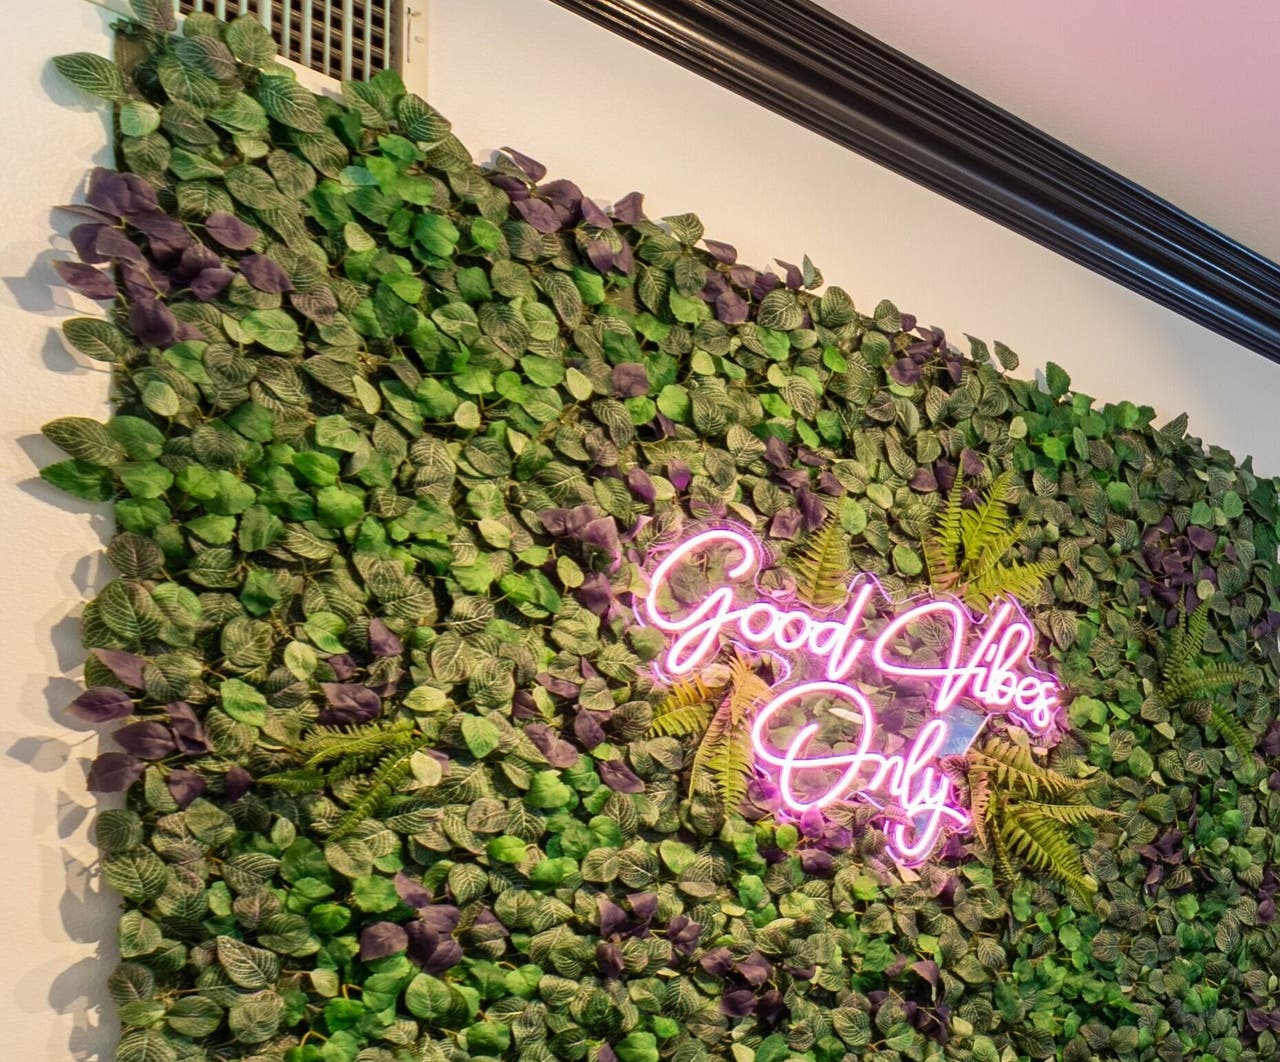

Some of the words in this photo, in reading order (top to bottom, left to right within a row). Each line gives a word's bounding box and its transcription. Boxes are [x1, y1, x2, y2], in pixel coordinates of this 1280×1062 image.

[646, 528, 874, 682] Good
[871, 601, 1060, 728] Vibes
[751, 680, 971, 857] Only
